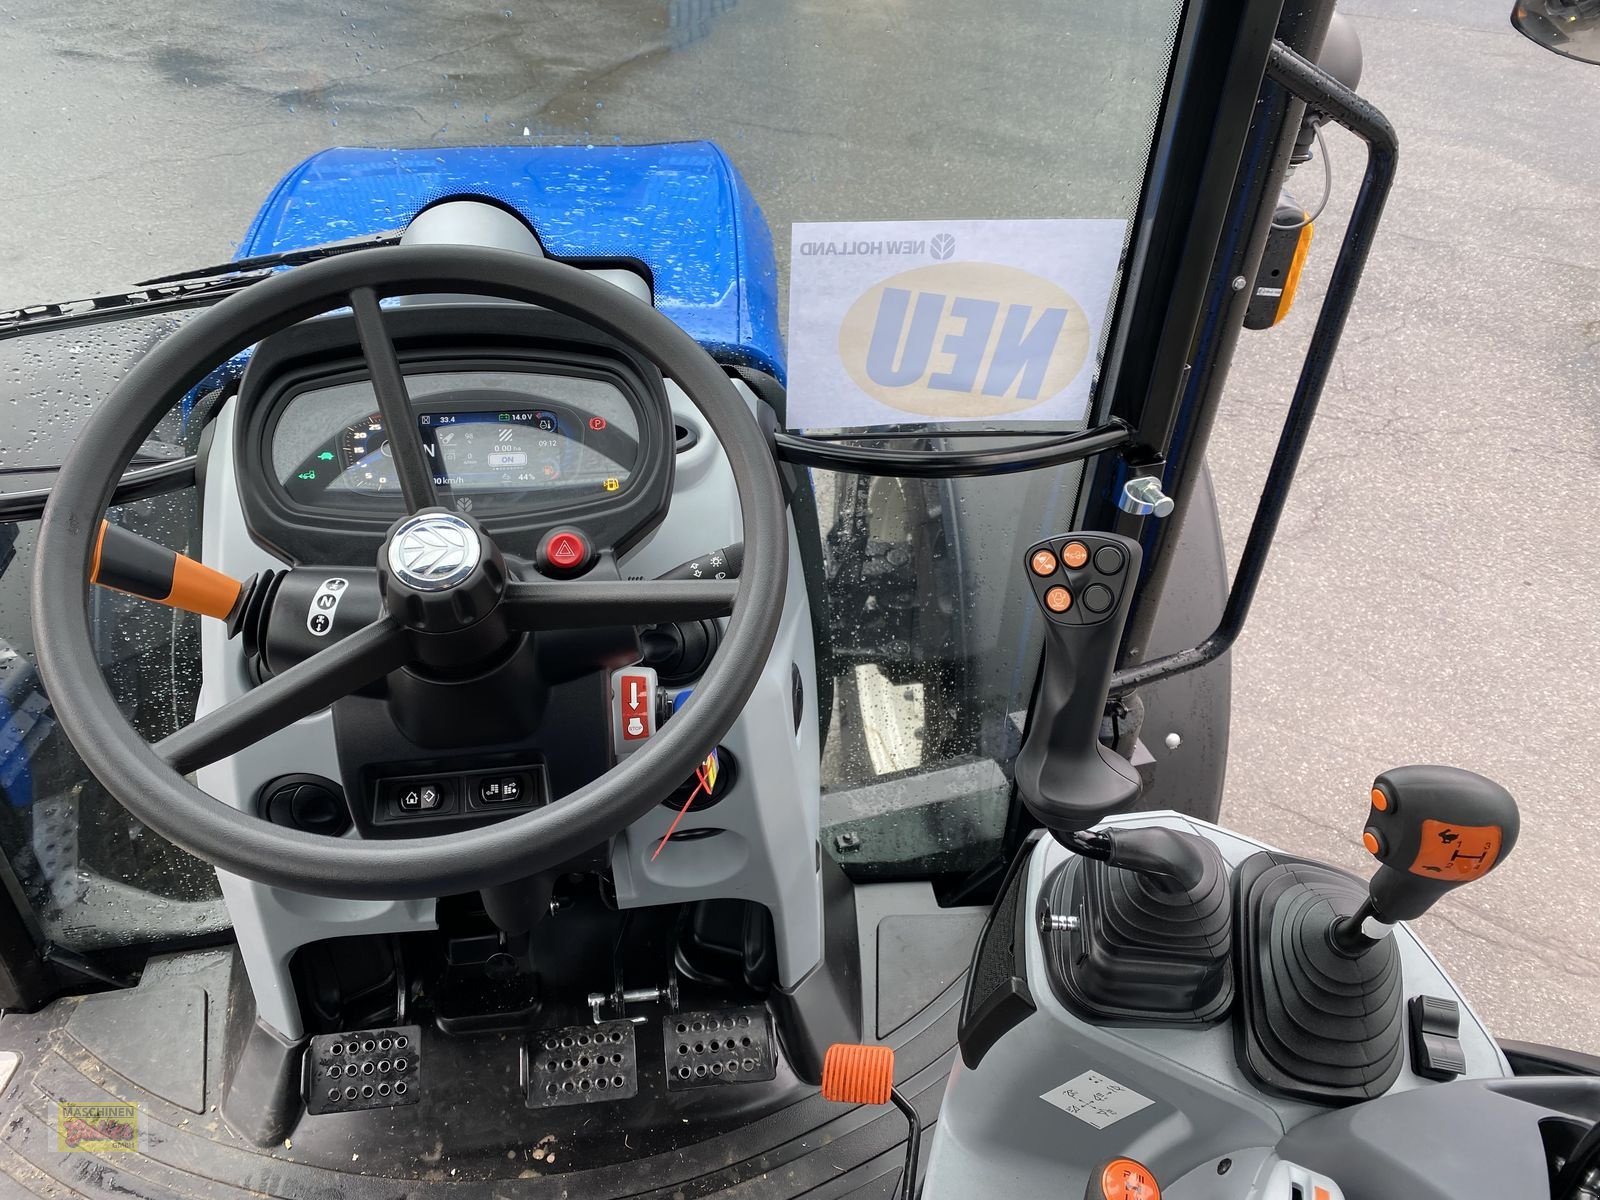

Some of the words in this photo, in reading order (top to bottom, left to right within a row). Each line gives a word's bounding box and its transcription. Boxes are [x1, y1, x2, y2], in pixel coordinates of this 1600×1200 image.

[353, 446, 365, 454] 15
[423, 443, 435, 458] N
[442, 477, 464, 485] km/h
[518, 473, 535, 481] 44%
[320, 596, 333, 608] N
